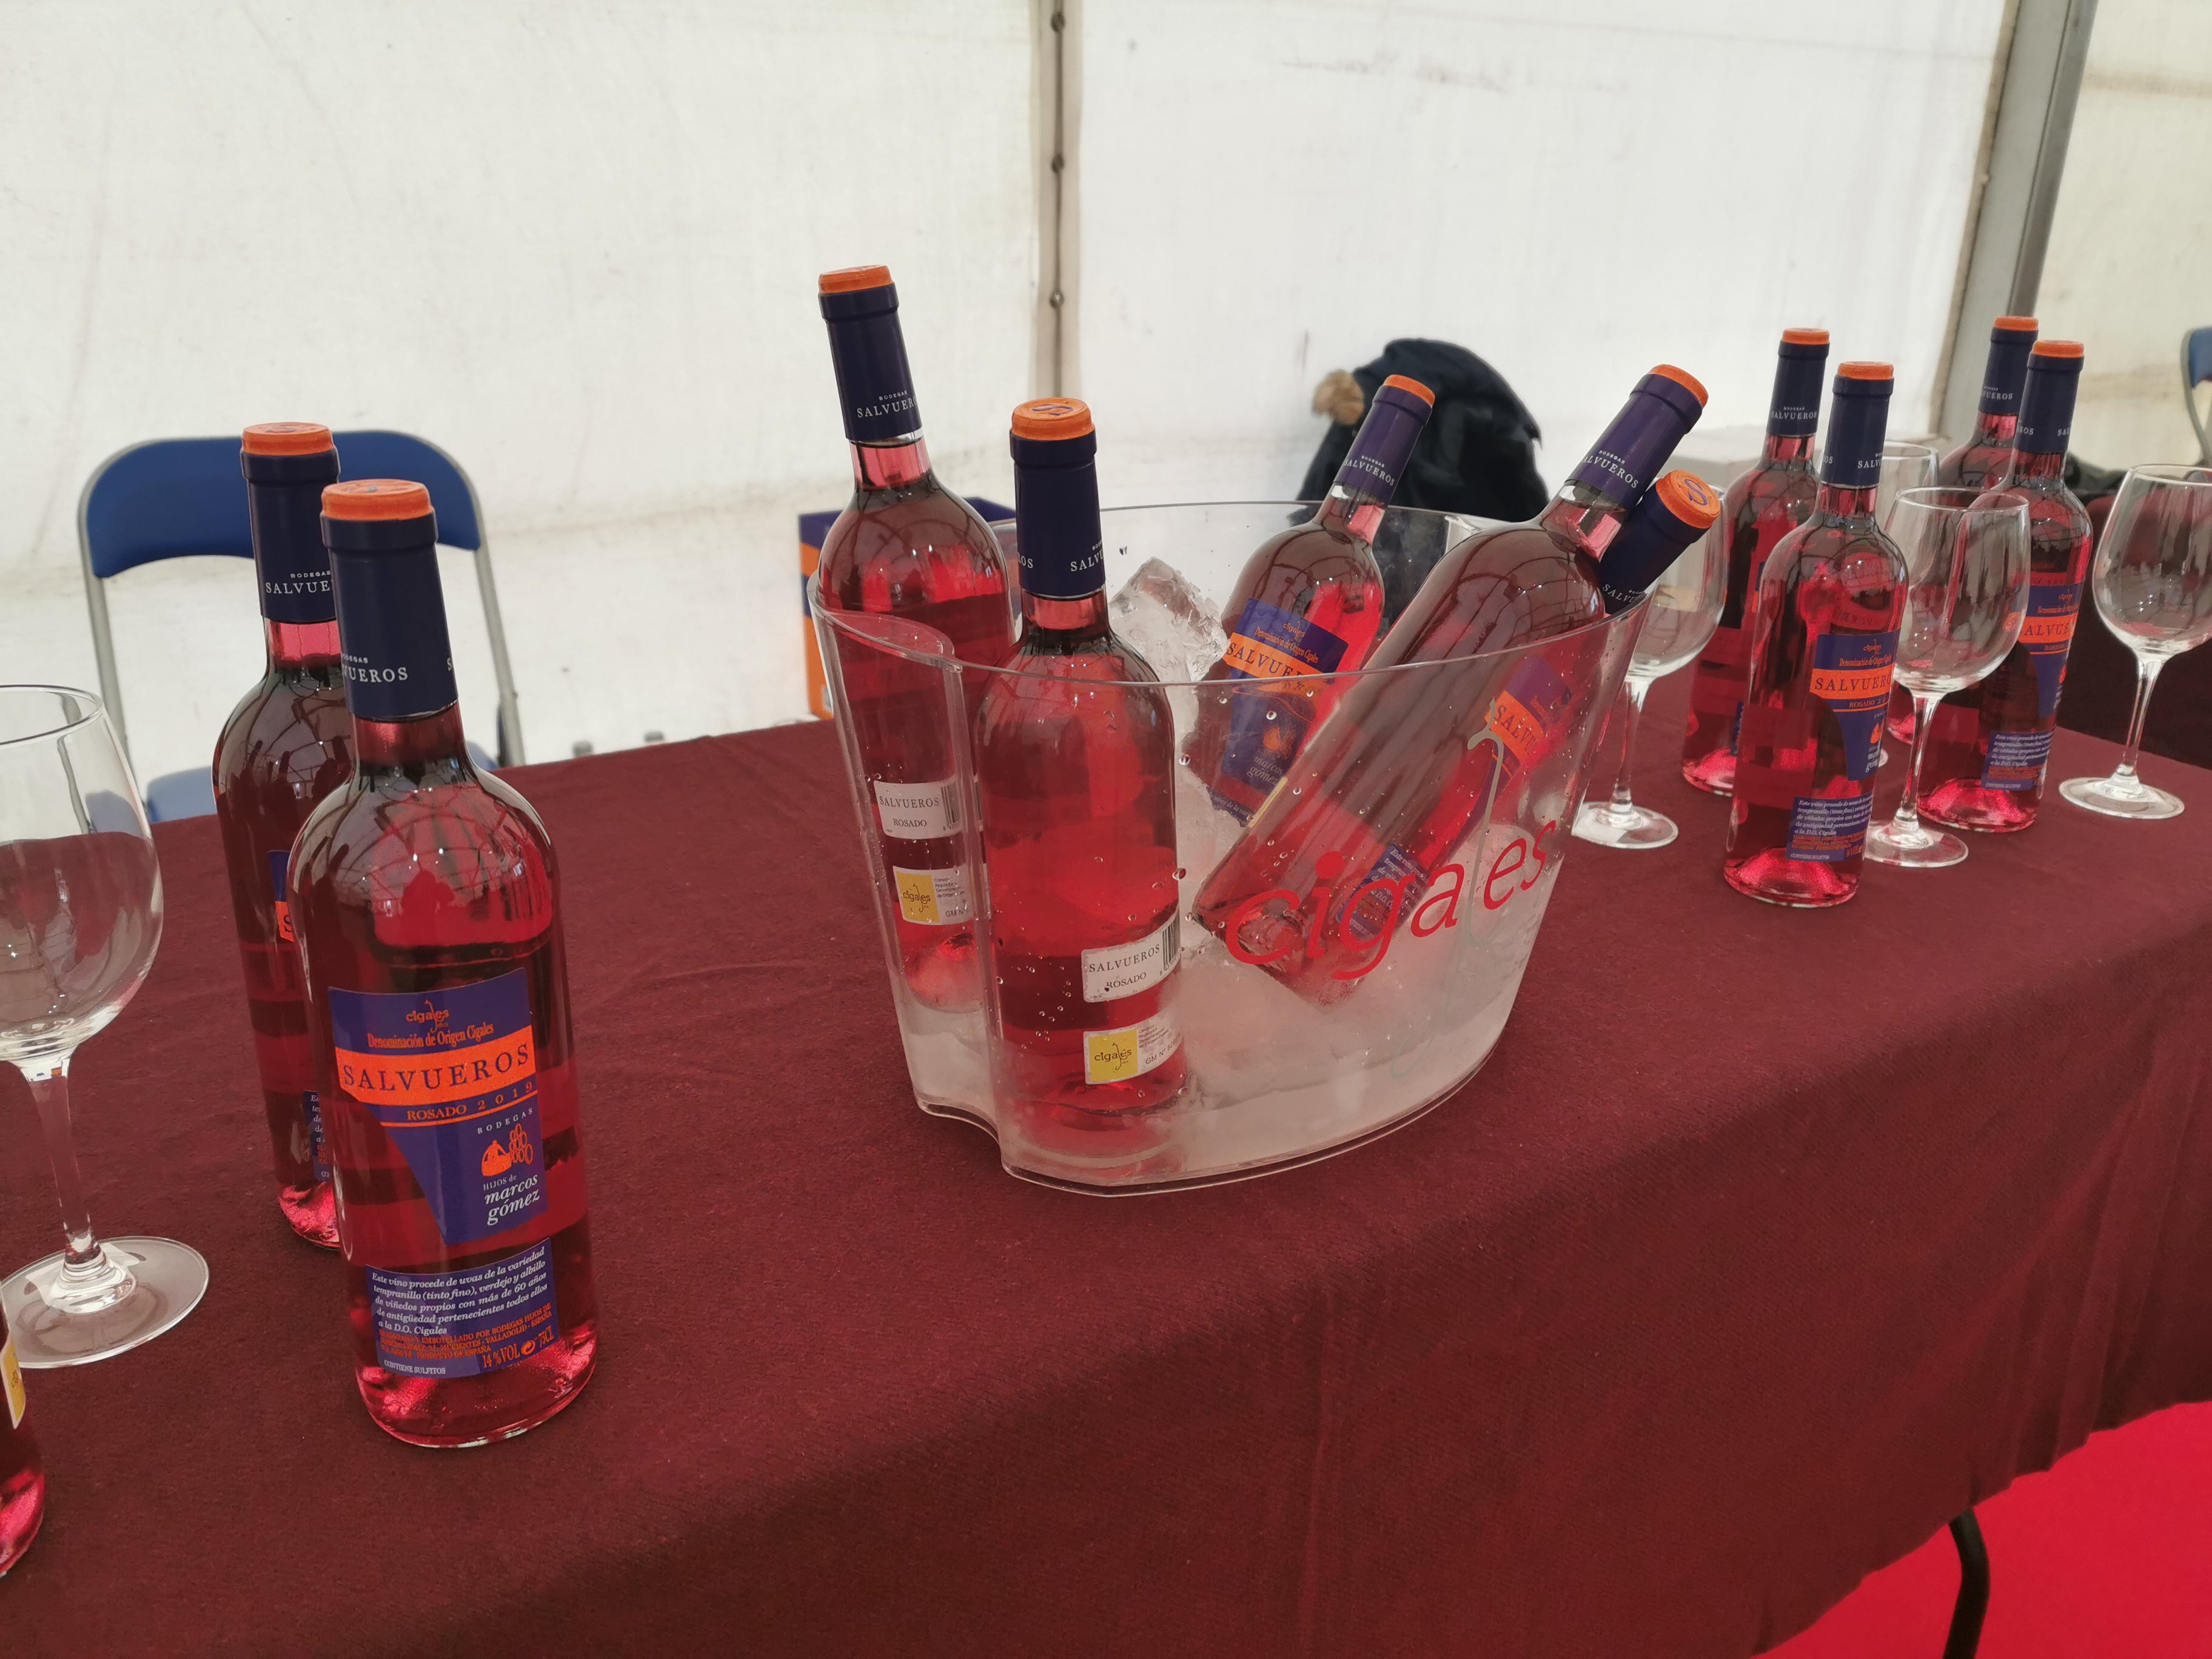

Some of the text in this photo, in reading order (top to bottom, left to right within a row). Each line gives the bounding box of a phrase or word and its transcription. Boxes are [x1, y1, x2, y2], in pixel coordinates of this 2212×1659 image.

[879, 390, 908, 401] BODEGAS
[1771, 411, 1817, 420] SALVUEROS
[1361, 455, 1385, 468] BODEGAS
[1598, 450, 1626, 464] BODEGAS
[1343, 458, 1395, 486] SALVUEROS
[1684, 478, 1708, 506] S
[266, 580, 330, 594] SALVUE
[1282, 620, 1306, 640] cigales
[1849, 699, 1875, 708] ROSADO
[1253, 756, 1284, 776] marcos
[879, 795, 939, 808] SALVUEROS
[893, 818, 927, 828] ROSADO
[1223, 699, 1557, 980] cigales
[1390, 848, 1403, 861] Este
[1378, 866, 1386, 875] de
[1089, 943, 1160, 973] SALVUEROS
[1106, 971, 1147, 988] ROSADO
[406, 1000, 450, 1027] cigales
[367, 1021, 494, 1049] Denominación de Origen Cigales
[1094, 1044, 1132, 1065] cigales
[1145, 1054, 1157, 1064] GM
[343, 1042, 529, 1091] SALVUEROS
[406, 1104, 468, 1121] ROSADO
[477, 1107, 534, 1135] BODEGAS
[483, 1173, 517, 1191] HIJOS de
[484, 1174, 538, 1205] marcos
[487, 1188, 540, 1226] gómez
[372, 1246, 545, 1289] Este vino procede de uvas de la variedad
[374, 1261, 546, 1301] tempranillo (tinto fino), verdejo y albillo
[375, 1272, 546, 1313] de viñedos propios con más de 60 años
[376, 1283, 548, 1325] de antigüedad pertenecientes todos ellos
[384, 1321, 392, 1330] la
[394, 1323, 412, 1333] D.O.
[414, 1326, 447, 1336] Cigales
[475, 1329, 491, 1339] POR
[492, 1318, 523, 1335] BODEGAS
[525, 1307, 543, 1323] HIJOS
[486, 1324, 527, 1344] VALLADOLID
[384, 1359, 446, 1375] CONTIENE SULFITOS
[482, 1353, 493, 1369] 14
